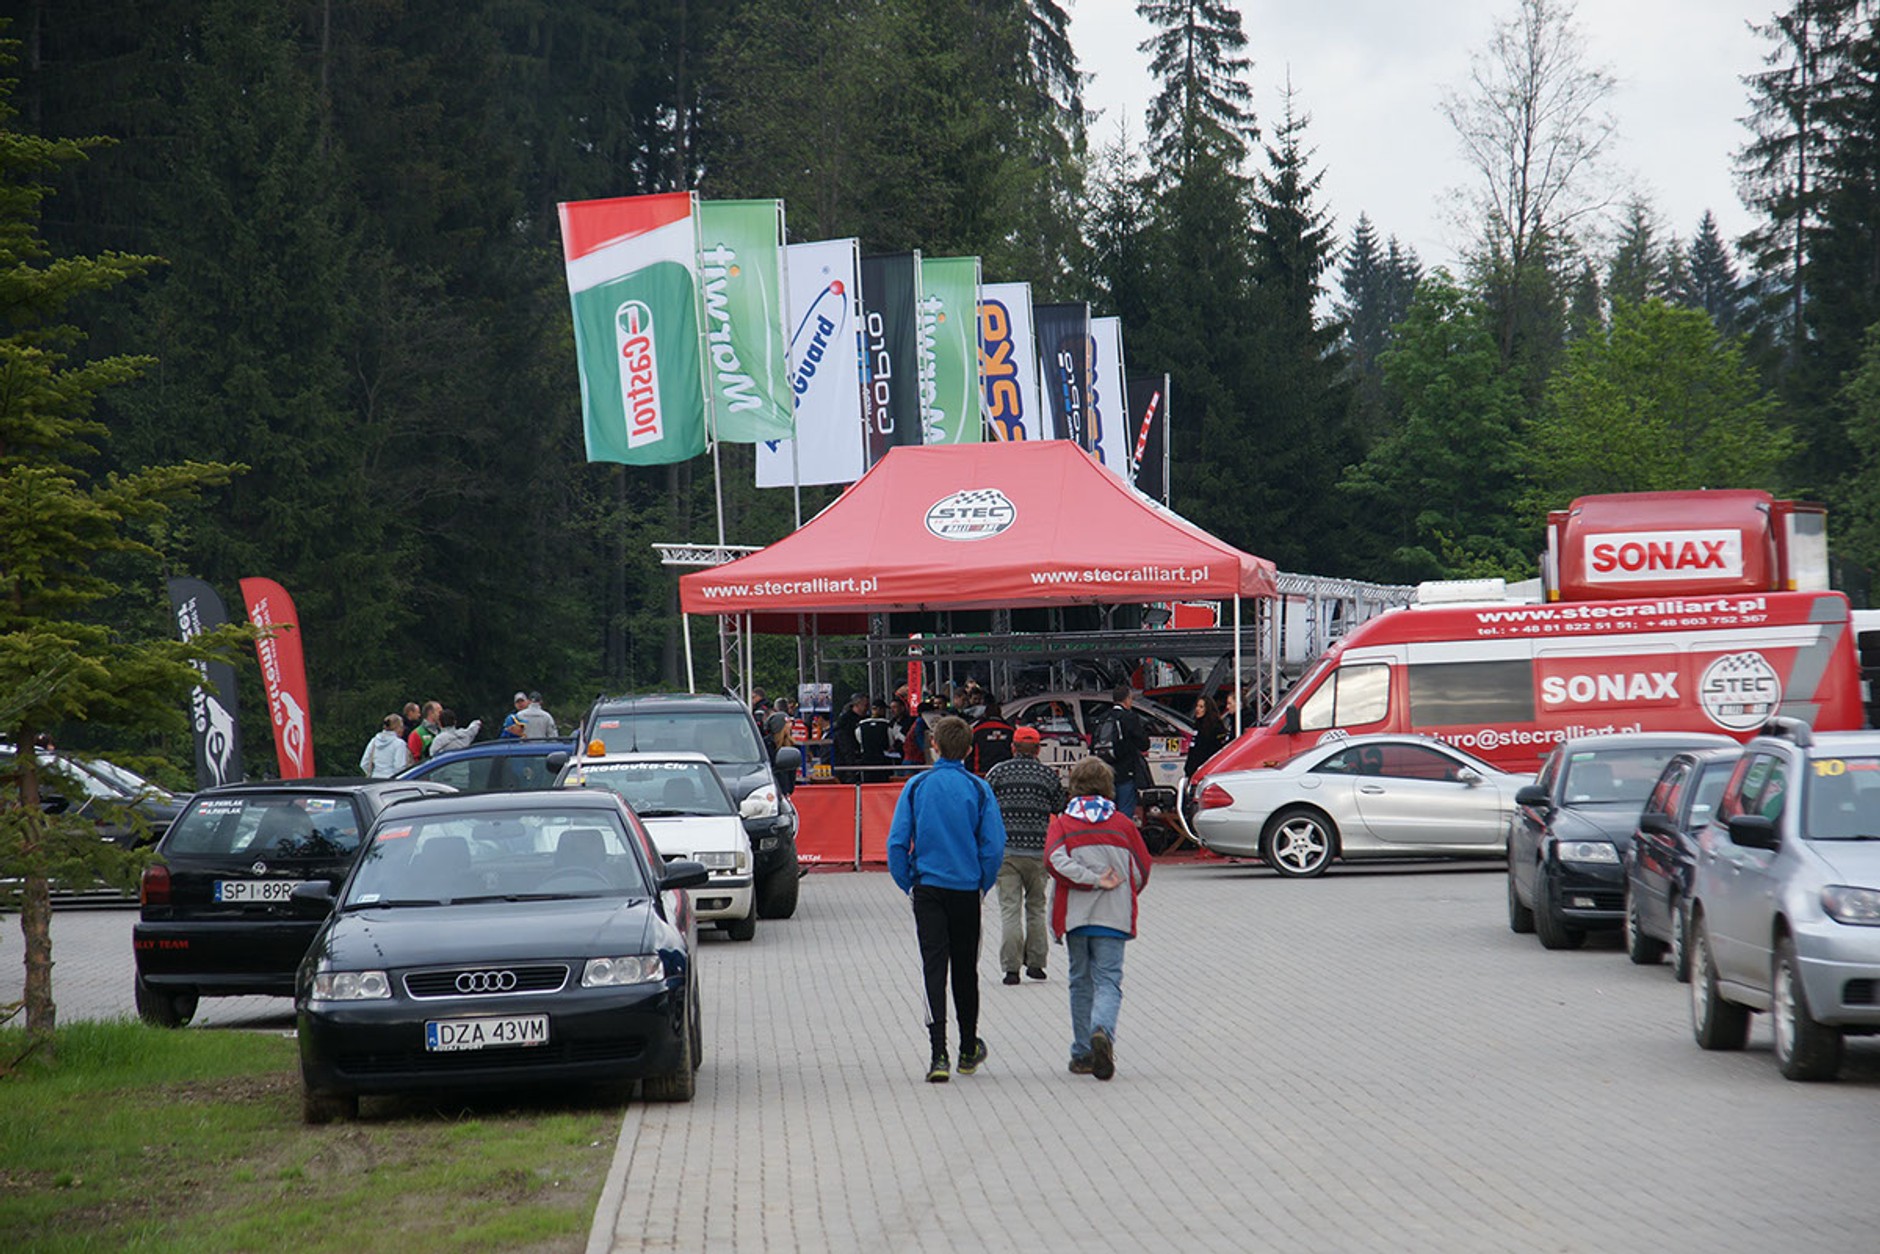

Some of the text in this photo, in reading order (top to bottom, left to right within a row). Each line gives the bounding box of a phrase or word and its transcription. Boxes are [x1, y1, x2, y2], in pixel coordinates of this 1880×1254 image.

[930, 506, 1011, 518] STEC
[1592, 540, 1727, 572] SONAX
[1031, 566, 1208, 584] www.stecralliart.pl
[702, 577, 878, 598] www.stecralliart.pl
[1476, 598, 1766, 623] www.stecralliart.pl
[1541, 671, 1680, 704] SONAX
[1704, 677, 1774, 692] STEC
[1167, 738, 1179, 752] 15
[1811, 759, 1845, 776] 10
[440, 1019, 544, 1044] DZA 43VM
